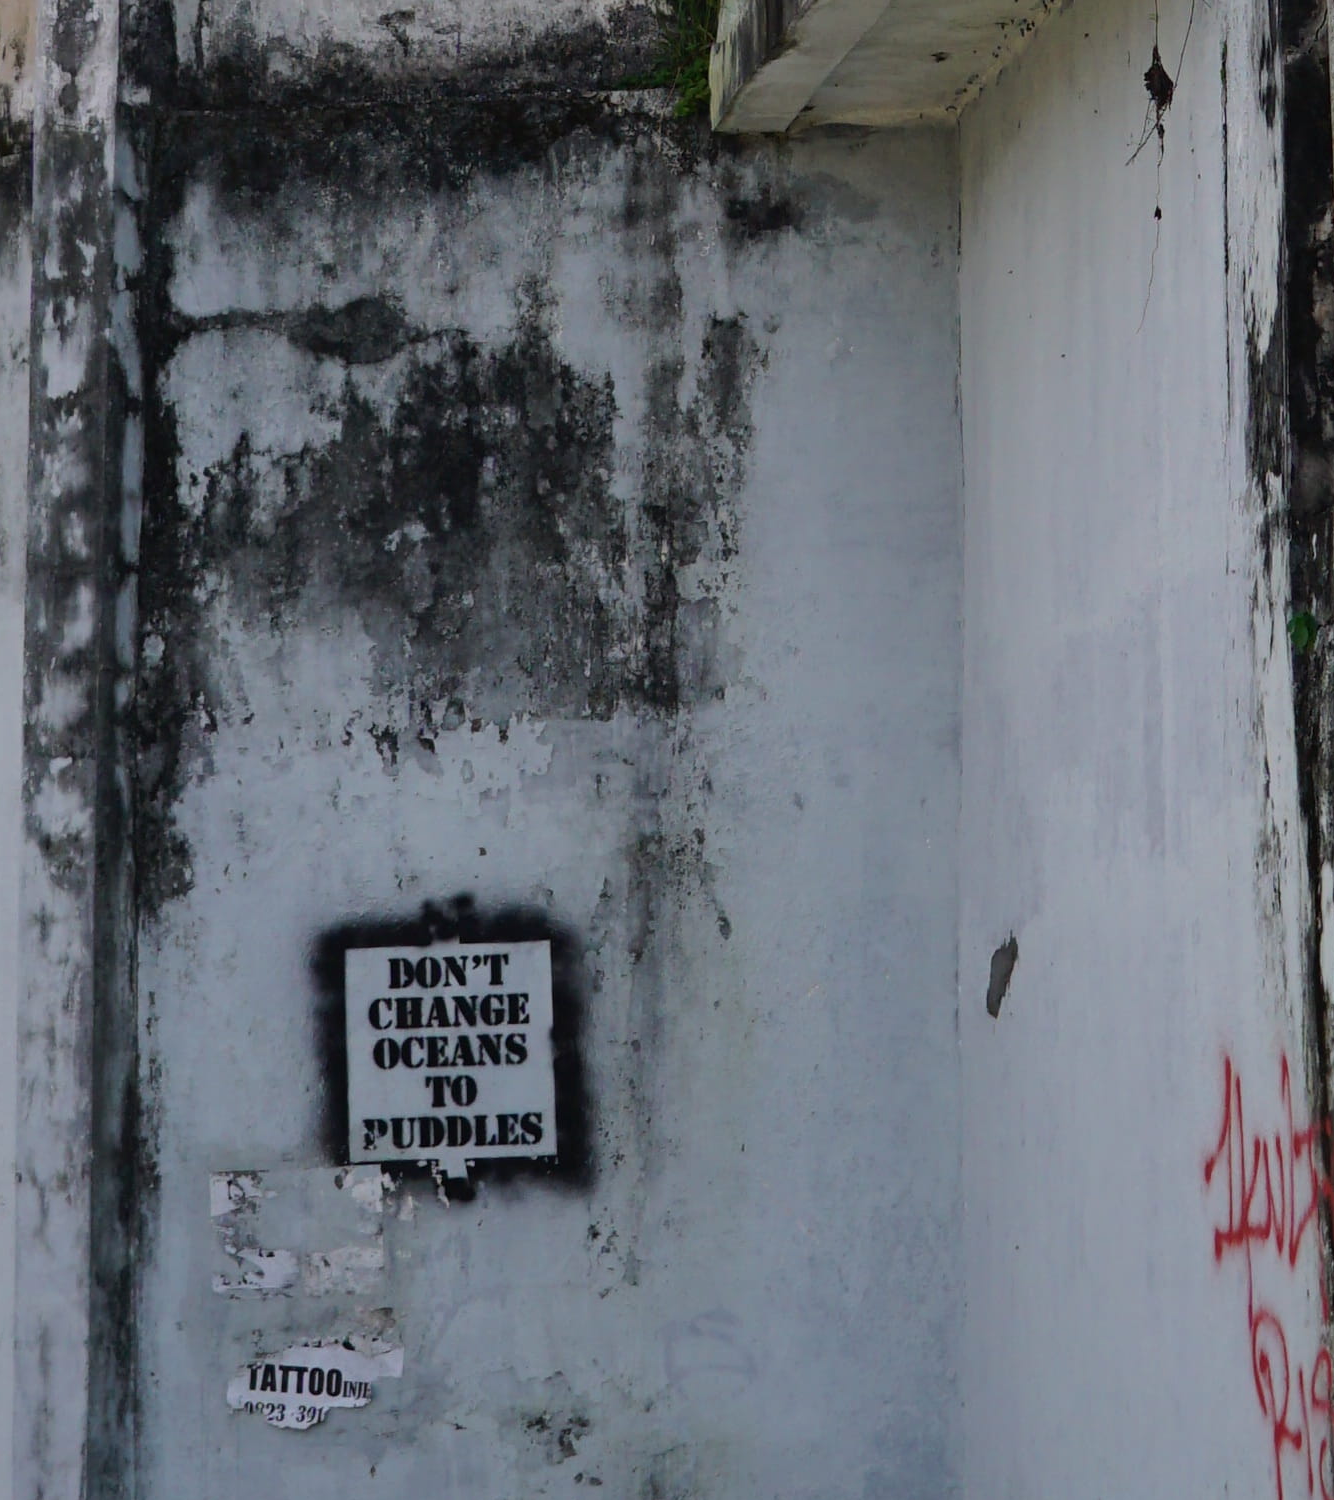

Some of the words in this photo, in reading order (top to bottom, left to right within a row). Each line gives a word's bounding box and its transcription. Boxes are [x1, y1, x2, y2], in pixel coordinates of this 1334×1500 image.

[387, 952, 509, 989] DON'T
[367, 992, 531, 1031] CHANGE
[372, 1033, 529, 1071] OCEANS
[424, 1074, 478, 1108] TO
[362, 1111, 544, 1152] PUDDLES
[246, 1363, 343, 1398] TATTOO
